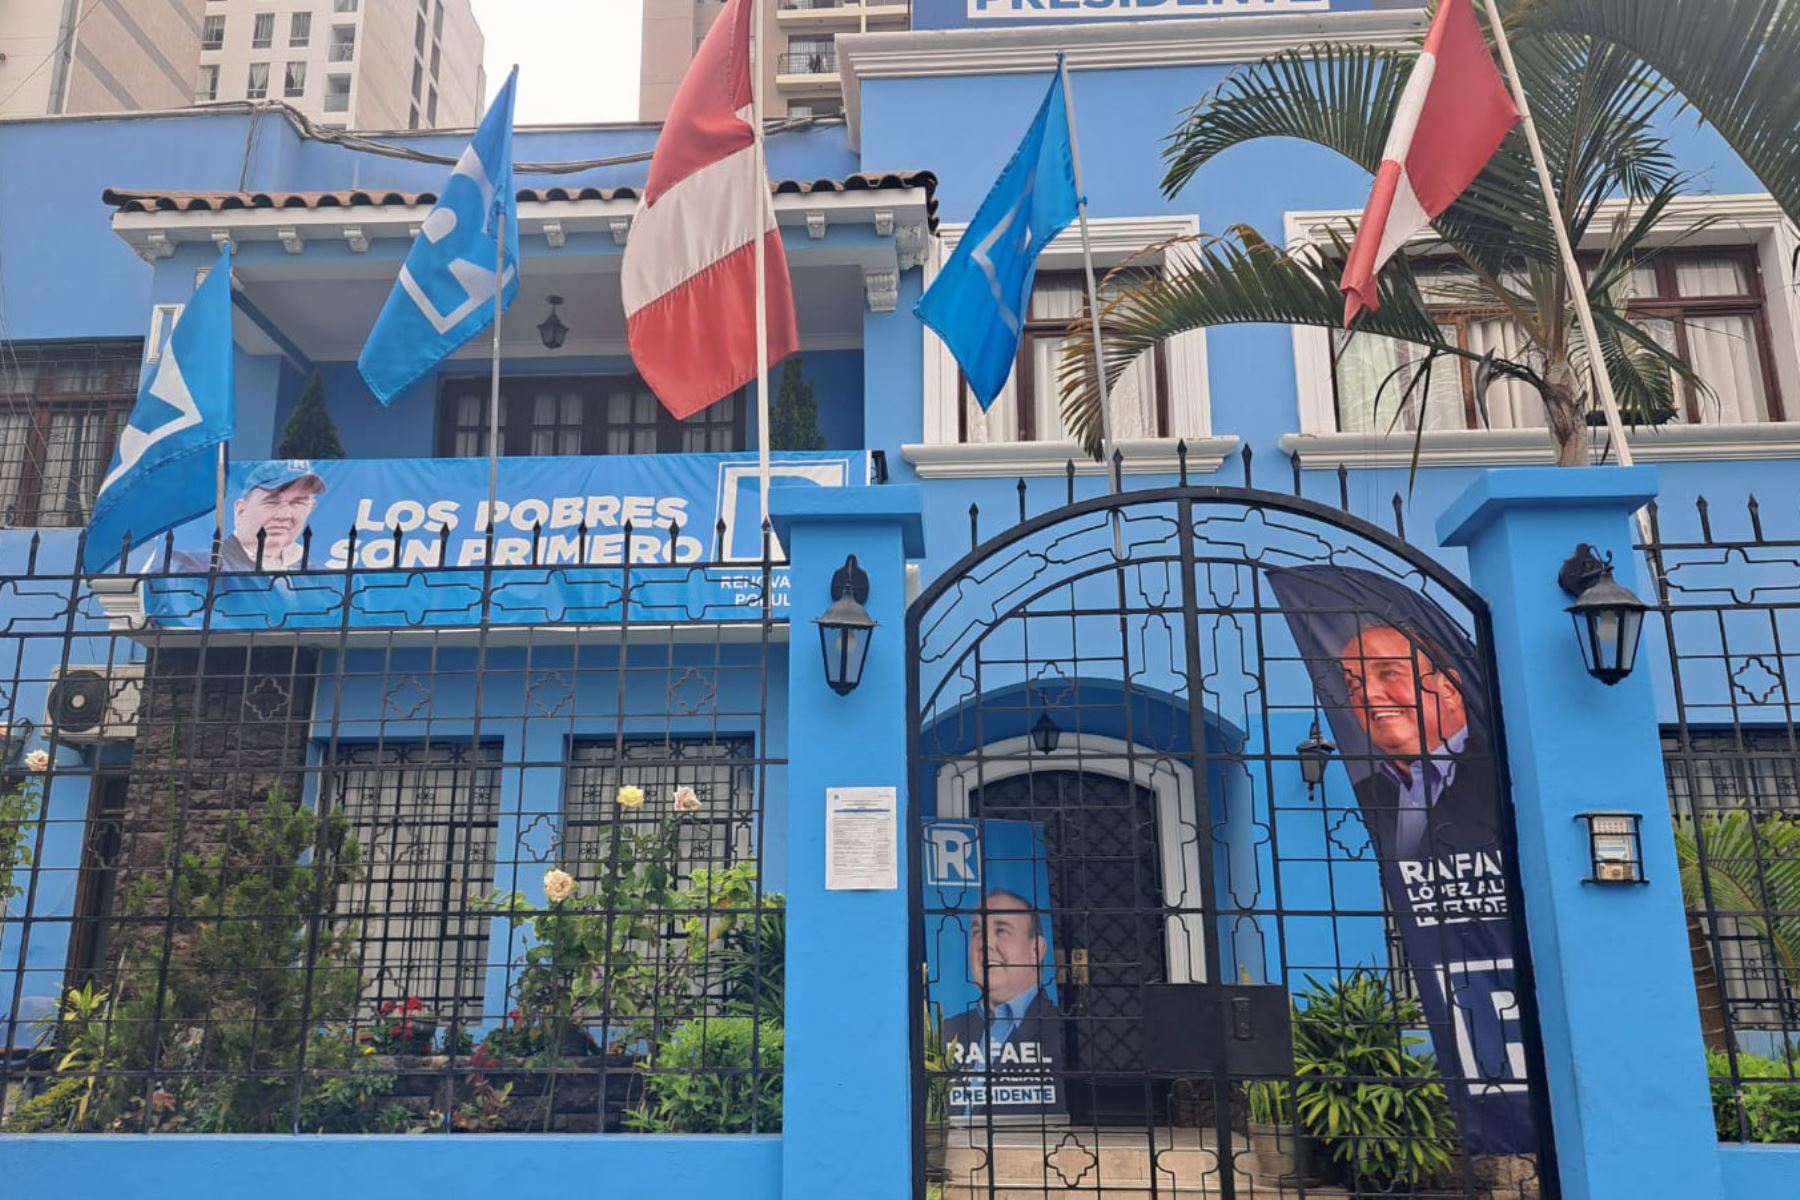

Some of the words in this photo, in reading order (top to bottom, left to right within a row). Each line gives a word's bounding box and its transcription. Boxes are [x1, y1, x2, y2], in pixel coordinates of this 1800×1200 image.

[356, 499, 459, 532] LOS
[474, 496, 689, 532] POBRES
[324, 539, 442, 570] SON
[457, 534, 704, 568] PRIMERO
[931, 829, 976, 880] R
[946, 1042, 1053, 1064] RAFAEL
[951, 1088, 1054, 1103] PREIDENTE
